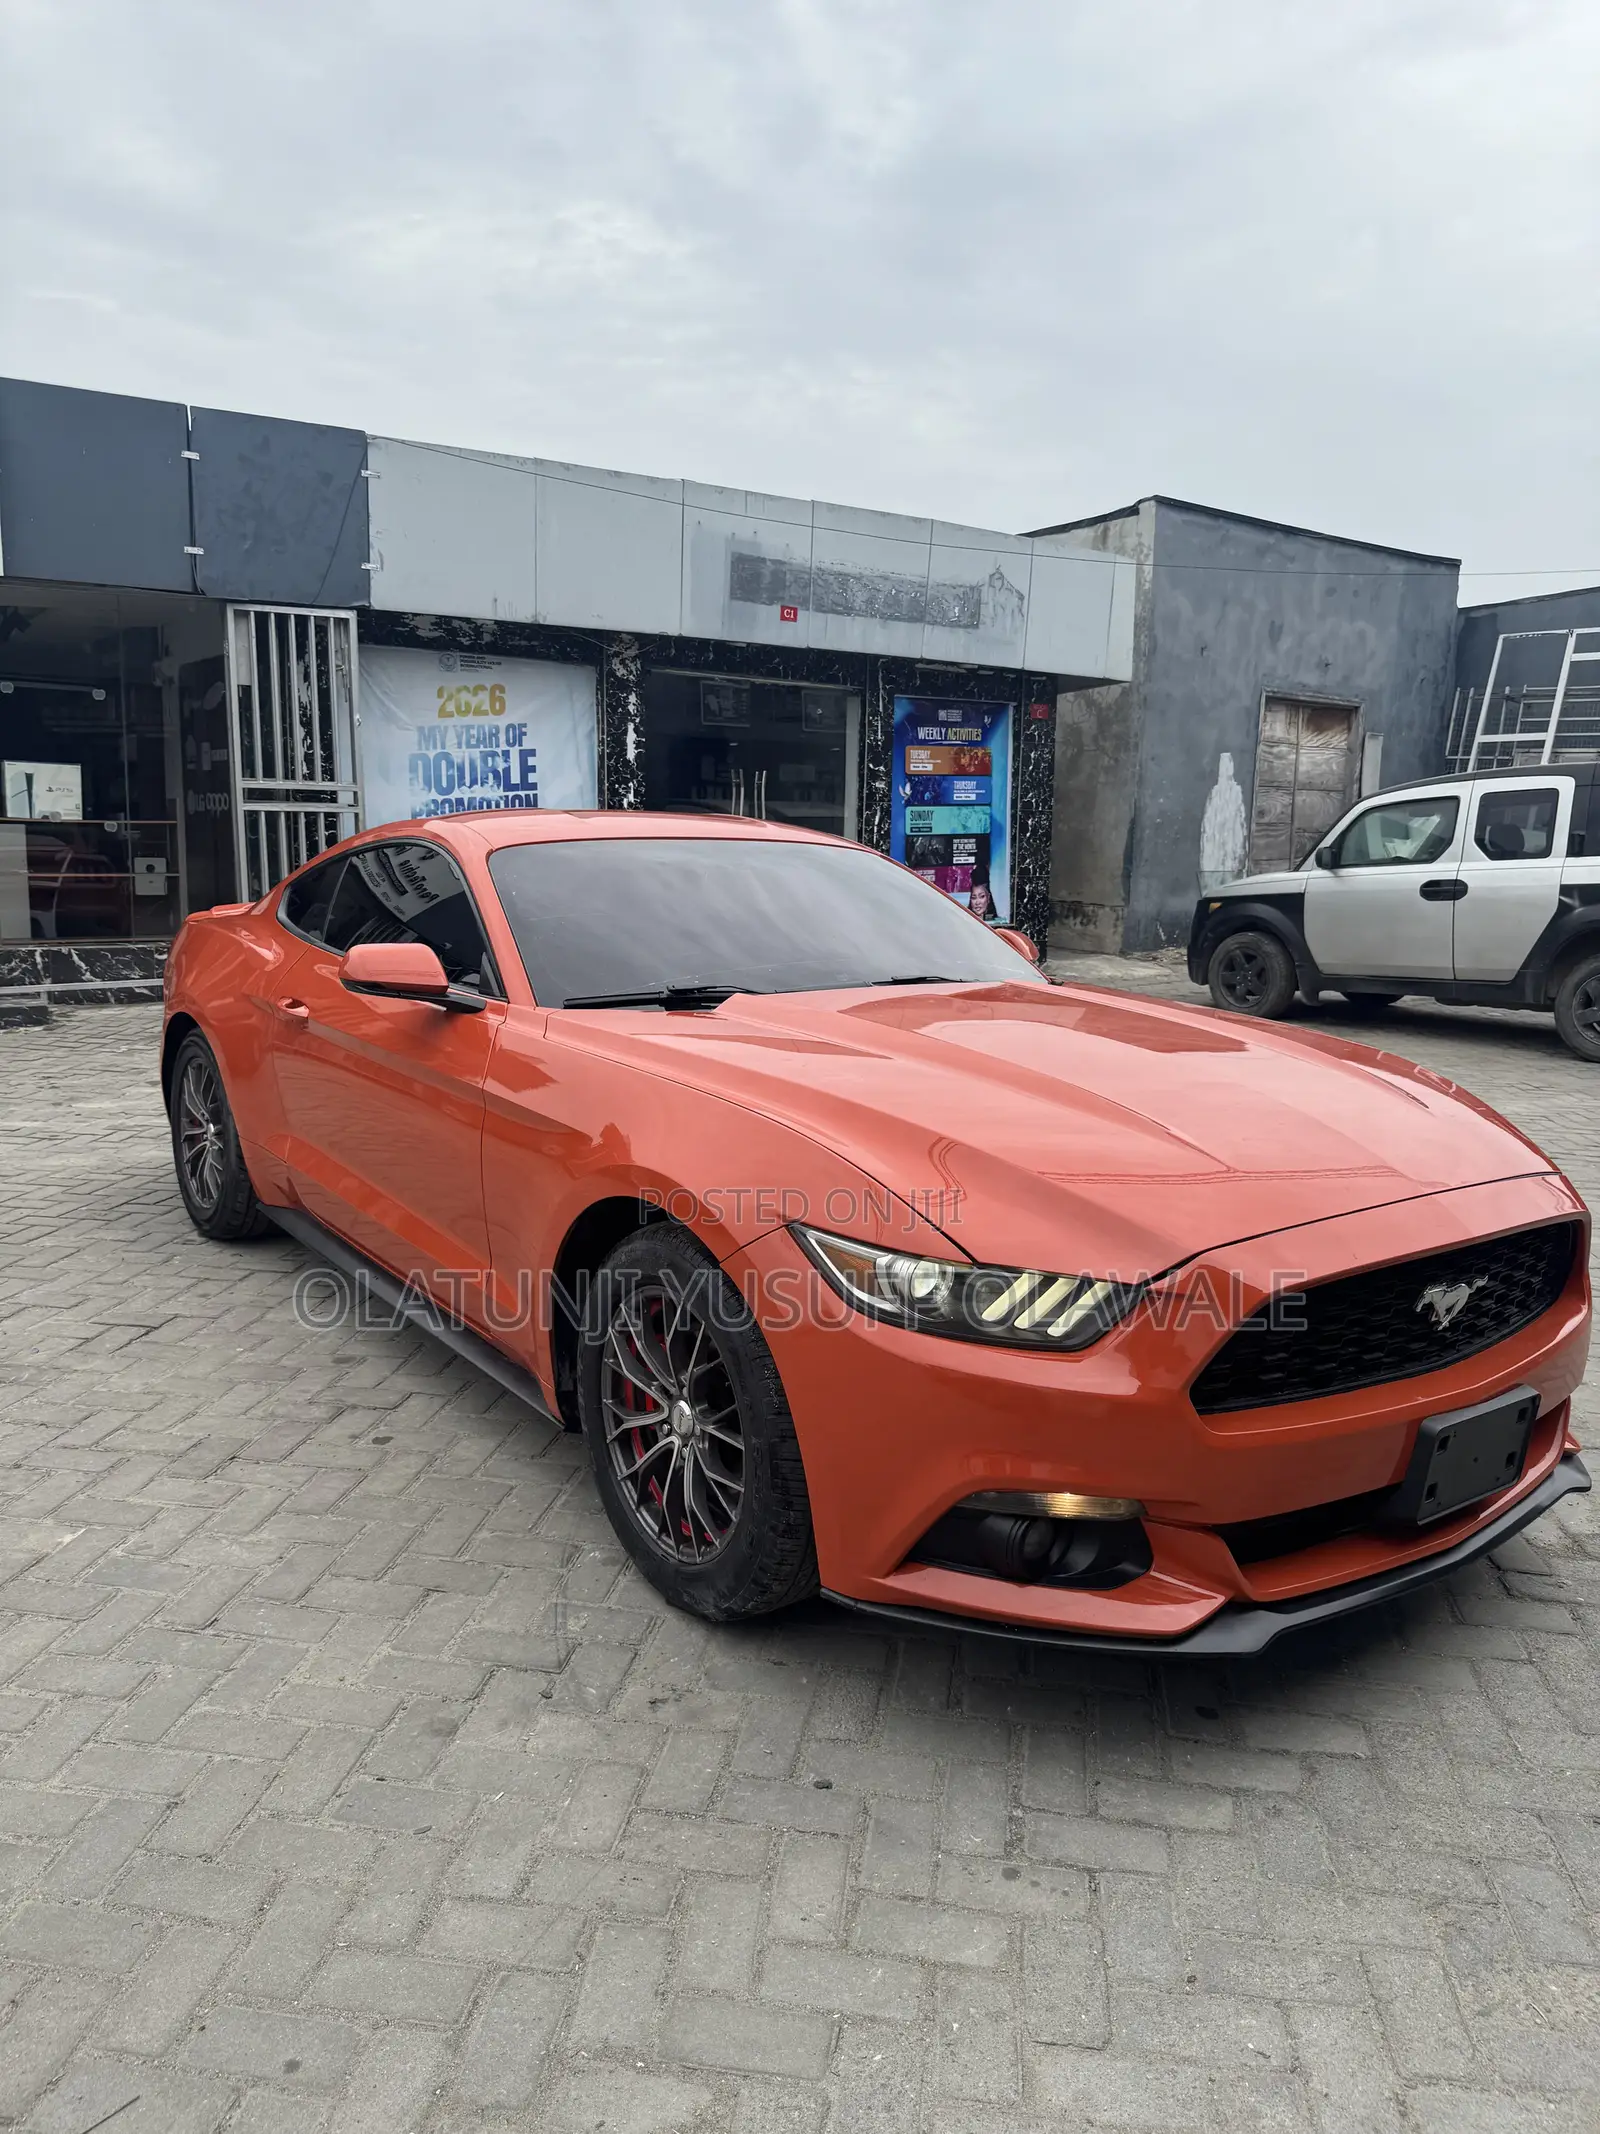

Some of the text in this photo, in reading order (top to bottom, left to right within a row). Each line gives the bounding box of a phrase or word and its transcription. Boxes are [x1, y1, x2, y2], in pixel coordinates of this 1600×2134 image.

[783, 608, 795, 619] C1
[436, 683, 507, 719] 2026
[416, 722, 528, 751] MY YEAR OF
[917, 726, 983, 741] WEEKLY ACTIVITIES
[910, 749, 931, 759] TUESDAY
[408, 748, 538, 796] DOUBLE
[909, 810, 935, 822] SUNDAY
